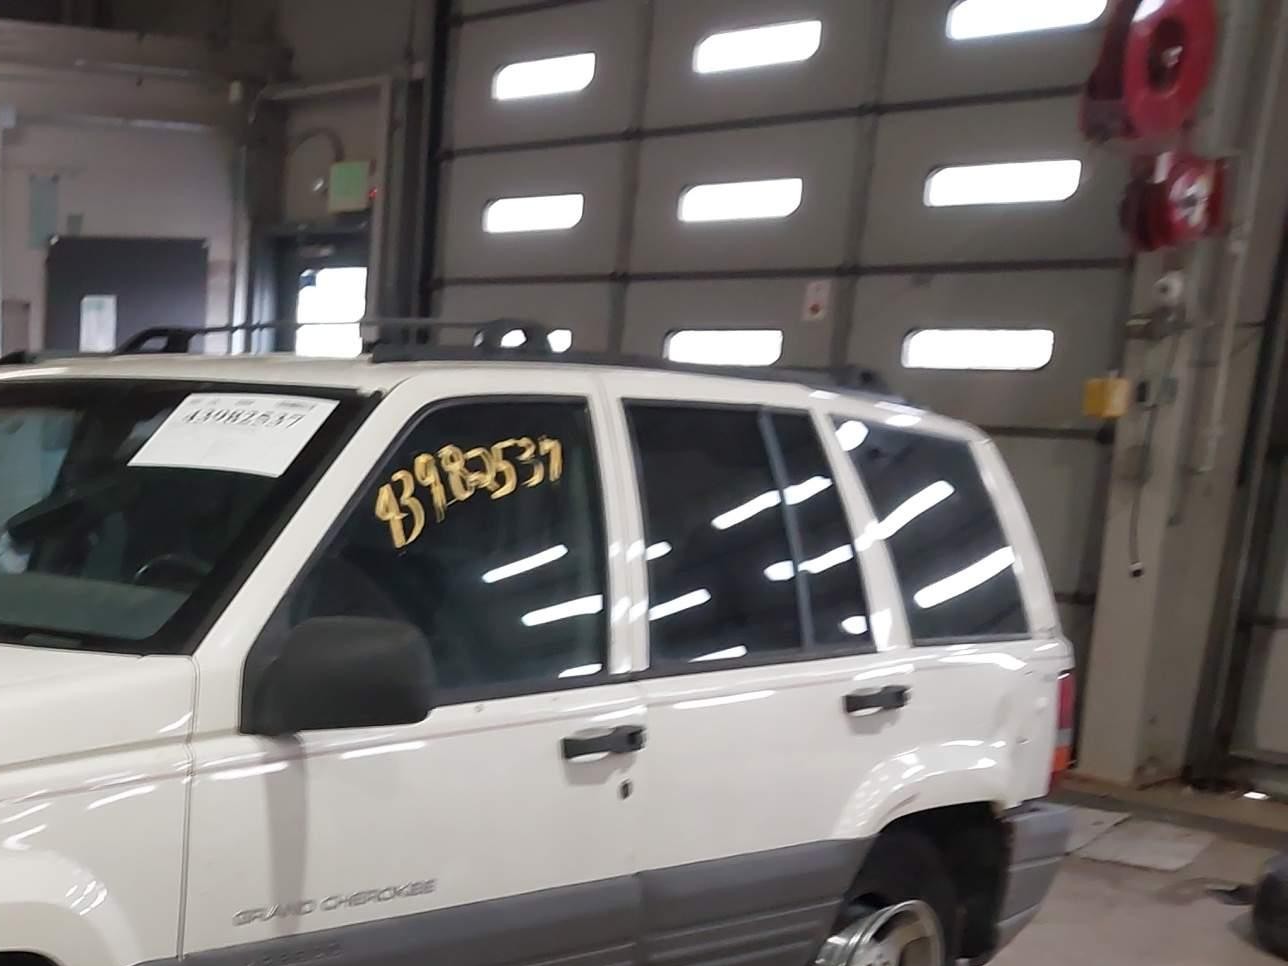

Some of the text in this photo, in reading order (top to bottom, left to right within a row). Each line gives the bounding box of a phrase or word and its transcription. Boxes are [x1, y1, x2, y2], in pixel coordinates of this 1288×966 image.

[184, 408, 305, 429] 43982537
[375, 435, 562, 548] 43982537
[232, 878, 438, 927] GRAND CHEROKEE
